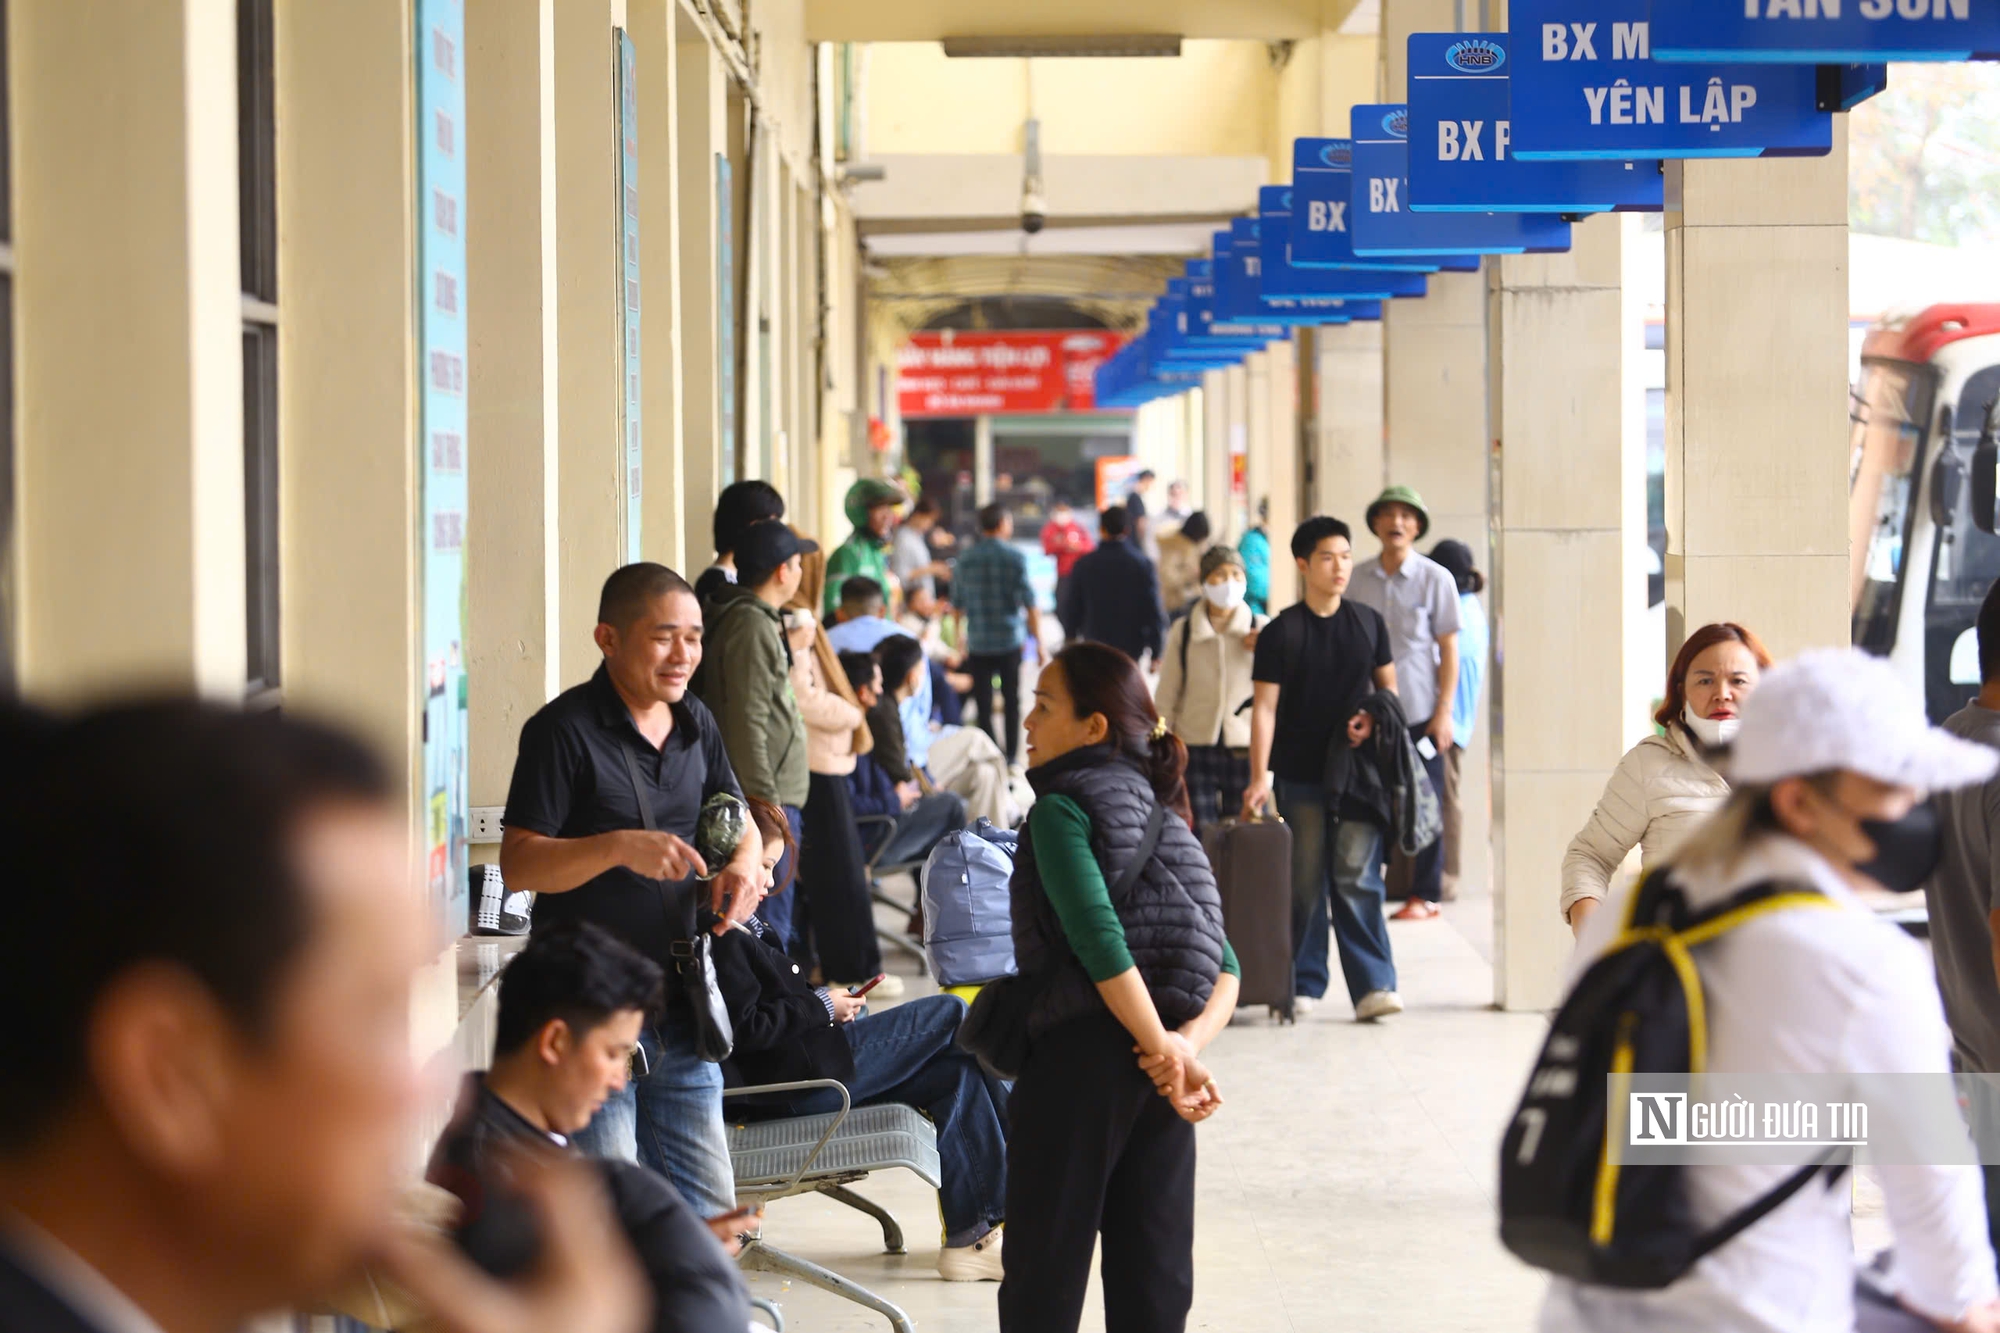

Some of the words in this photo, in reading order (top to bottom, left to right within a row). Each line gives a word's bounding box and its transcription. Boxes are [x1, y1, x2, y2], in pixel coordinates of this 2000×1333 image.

[1459, 55, 1492, 65] HNB
[1543, 23, 1597, 61] BX
[1583, 79, 1665, 124] YÊN
[1679, 77, 1757, 131] LẬP
[1438, 120, 1484, 161] BX
[1369, 178, 1400, 213] BX
[1308, 201, 1347, 232] BX
